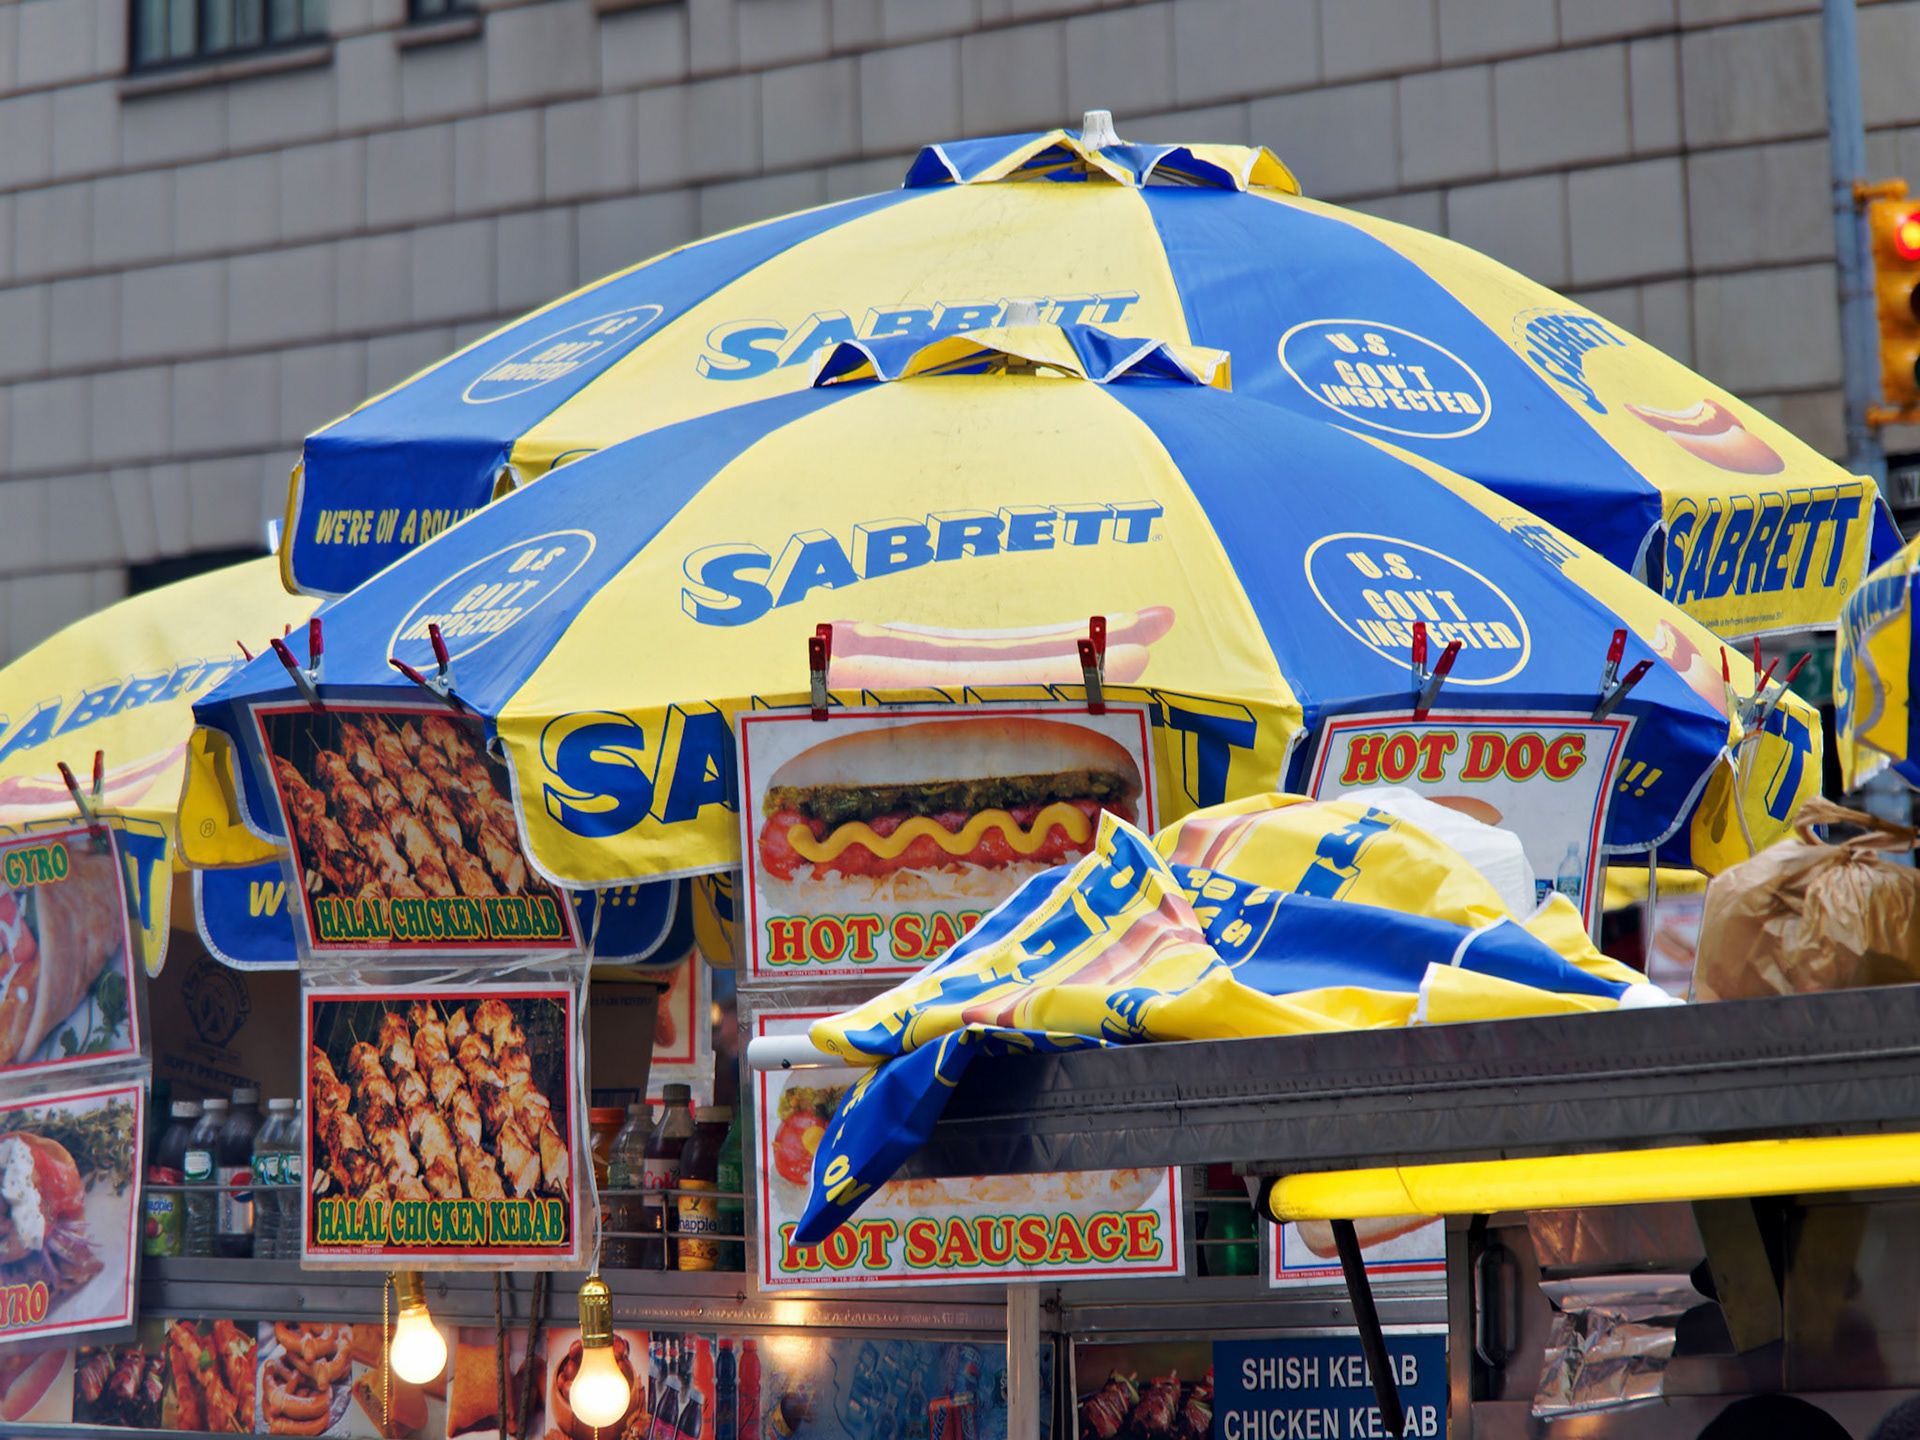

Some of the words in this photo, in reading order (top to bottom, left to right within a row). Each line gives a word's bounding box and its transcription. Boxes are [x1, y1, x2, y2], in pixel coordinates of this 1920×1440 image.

[695, 290, 1140, 381] SABRTT
[1325, 332, 1397, 358] U.S.
[1333, 359, 1434, 391] GOV'T
[1320, 383, 1482, 415] INSPECTED
[315, 510, 374, 547] WE'RE
[376, 508, 400, 544] ON
[400, 509, 417, 544] A
[1664, 482, 1863, 604] SABRETT
[682, 500, 1164, 627] SABRETT
[1346, 552, 1422, 580] U.S.
[399, 607, 523, 640] INSPECTED
[1362, 588, 1468, 621] GOV'T
[0, 655, 248, 765] ABRET
[1340, 731, 1458, 785] HOT
[1459, 731, 1586, 782] DOG
[4, 842, 69, 889] GYRO
[315, 897, 392, 940] HALAL
[391, 896, 488, 940] CHICKEN
[485, 896, 562, 940] KEBAB
[765, 914, 884, 966] HOT
[317, 1197, 388, 1245] HALAL
[386, 1197, 487, 1245] CHICKEN
[485, 1197, 564, 1245] KEBAB
[779, 1219, 897, 1272] HOT
[904, 1210, 1163, 1269] SAUSAGE
[1242, 1357, 1320, 1391] SHISH
[1224, 1407, 1340, 1440] CHICKEN
[1350, 1405, 1439, 1440] KEAB
